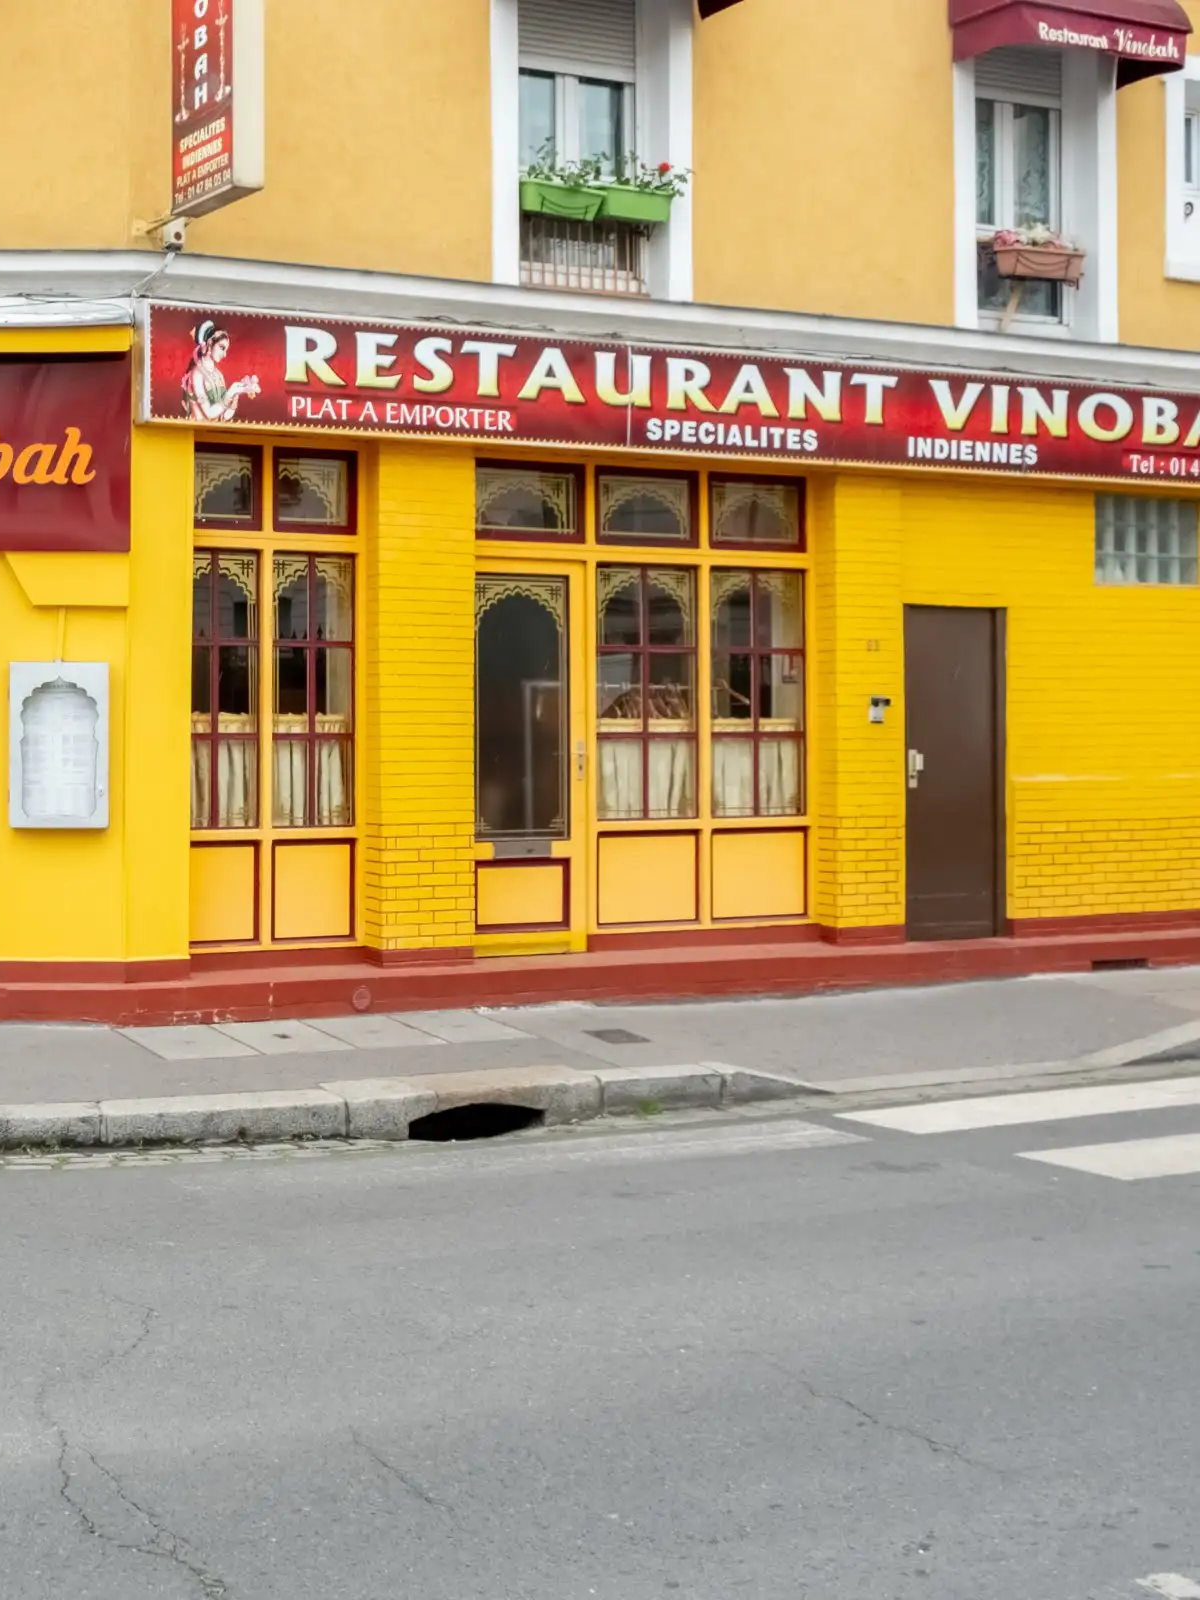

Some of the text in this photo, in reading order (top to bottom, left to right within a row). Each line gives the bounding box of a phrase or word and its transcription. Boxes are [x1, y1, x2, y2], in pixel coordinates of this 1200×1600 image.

[1038, 21, 1180, 58] Restaurant Vinobah
[179, 116, 226, 153] SPECIALITES
[176, 171, 191, 188] PLAT
[197, 152, 229, 178] EMPORTER
[182, 137, 223, 170] INDIENNES
[174, 190, 184, 205] Tel
[187, 185, 195, 199] 01
[196, 180, 204, 194] 47
[205, 176, 212, 191] 84
[213, 171, 221, 186] 05
[222, 167, 231, 182] 04
[284, 325, 899, 425] RESTAURANT
[291, 396, 514, 432] PLAT A EMPORTER
[646, 417, 819, 451] SPECIALITES
[907, 436, 1038, 466] INDIENNES
[1129, 454, 1155, 474] Tel
[1169, 456, 1186, 476] 01
